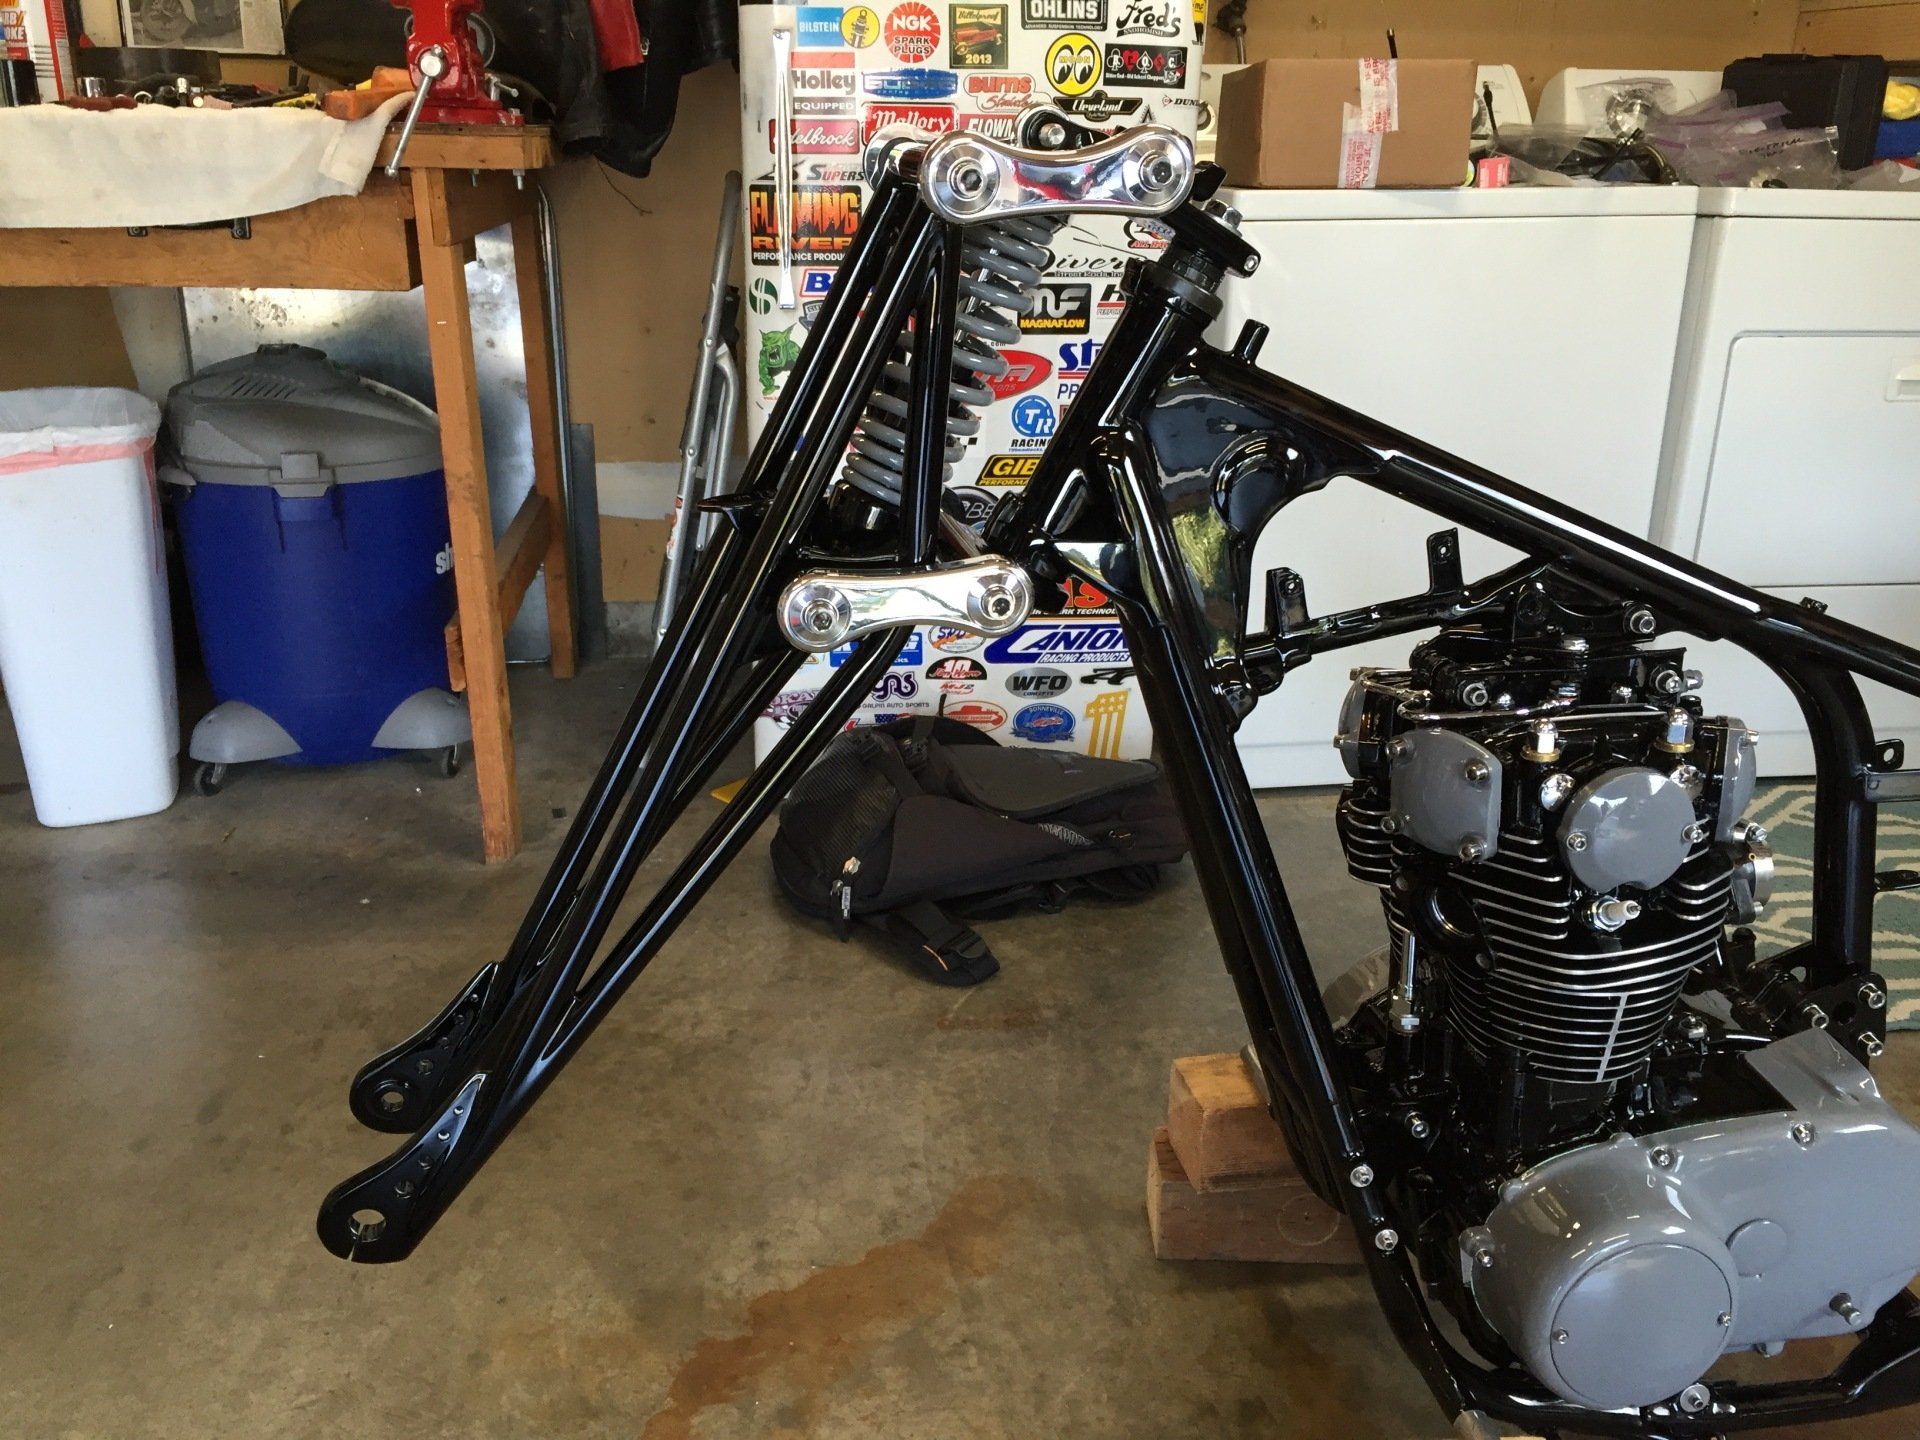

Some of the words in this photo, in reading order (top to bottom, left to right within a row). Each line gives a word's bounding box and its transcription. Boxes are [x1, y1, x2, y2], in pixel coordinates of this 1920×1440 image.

[799, 20, 839, 33] BILSTEIN
[892, 16, 931, 32] NGK
[894, 36, 931, 45] SPARK
[894, 45, 930, 55] PLUGS
[965, 53, 992, 64] 2013
[1058, 55, 1091, 64] MOON
[791, 70, 856, 95] Holley
[794, 102, 854, 111] EQUIPPED
[1072, 100, 1124, 112] Cleveland
[773, 126, 855, 147] delbrock
[750, 191, 859, 235] FLMING
[753, 252, 812, 261] PERFORANCE
[813, 252, 846, 261] PRODU
[1020, 319, 1086, 329] MAGNAFLOW
[1040, 652, 1077, 663] RACING
[1078, 652, 1130, 663] PRODUCTS
[1012, 675, 1068, 691] WFO
